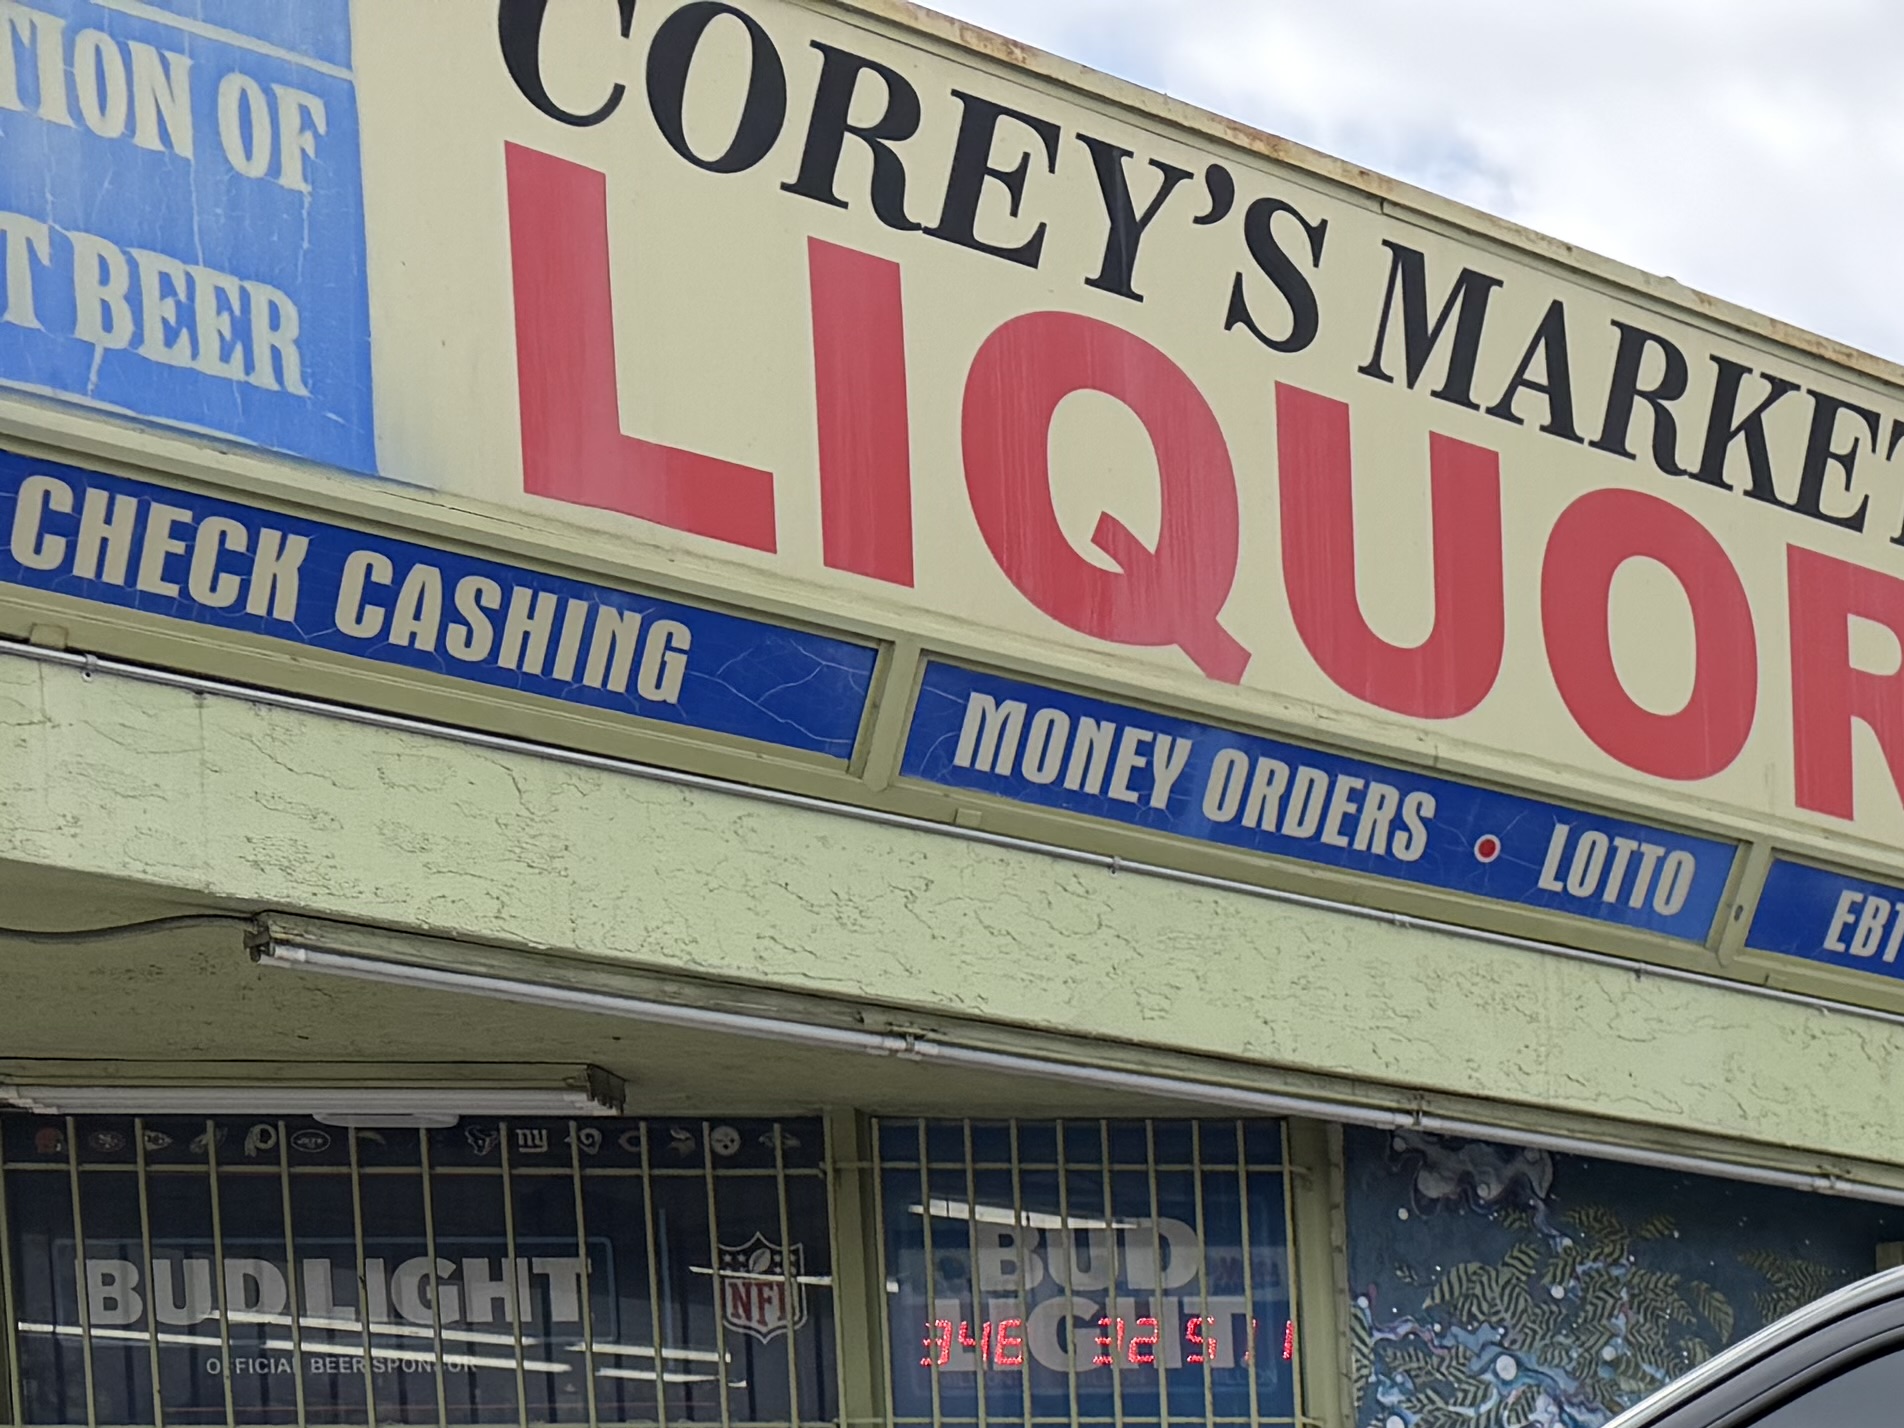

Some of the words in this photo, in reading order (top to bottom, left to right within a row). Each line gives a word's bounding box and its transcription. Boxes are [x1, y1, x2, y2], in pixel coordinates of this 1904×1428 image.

[218, 72, 327, 192] OF
[498, 0, 1328, 353] COREY'S
[68, 230, 312, 397] BEER
[8, 474, 310, 624] CHECK
[334, 549, 693, 705] CASHING
[953, 691, 1193, 809] MONEY
[1201, 747, 1437, 862] ORDERS
[1537, 823, 1696, 917] LOTTO
[76, 1257, 287, 1325] BUD
[303, 1256, 593, 1325] LIGHT
[978, 1217, 1199, 1291] BUD
[311, 1357, 365, 1375] BEER
[935, 1296, 1250, 1371] LIGHT
